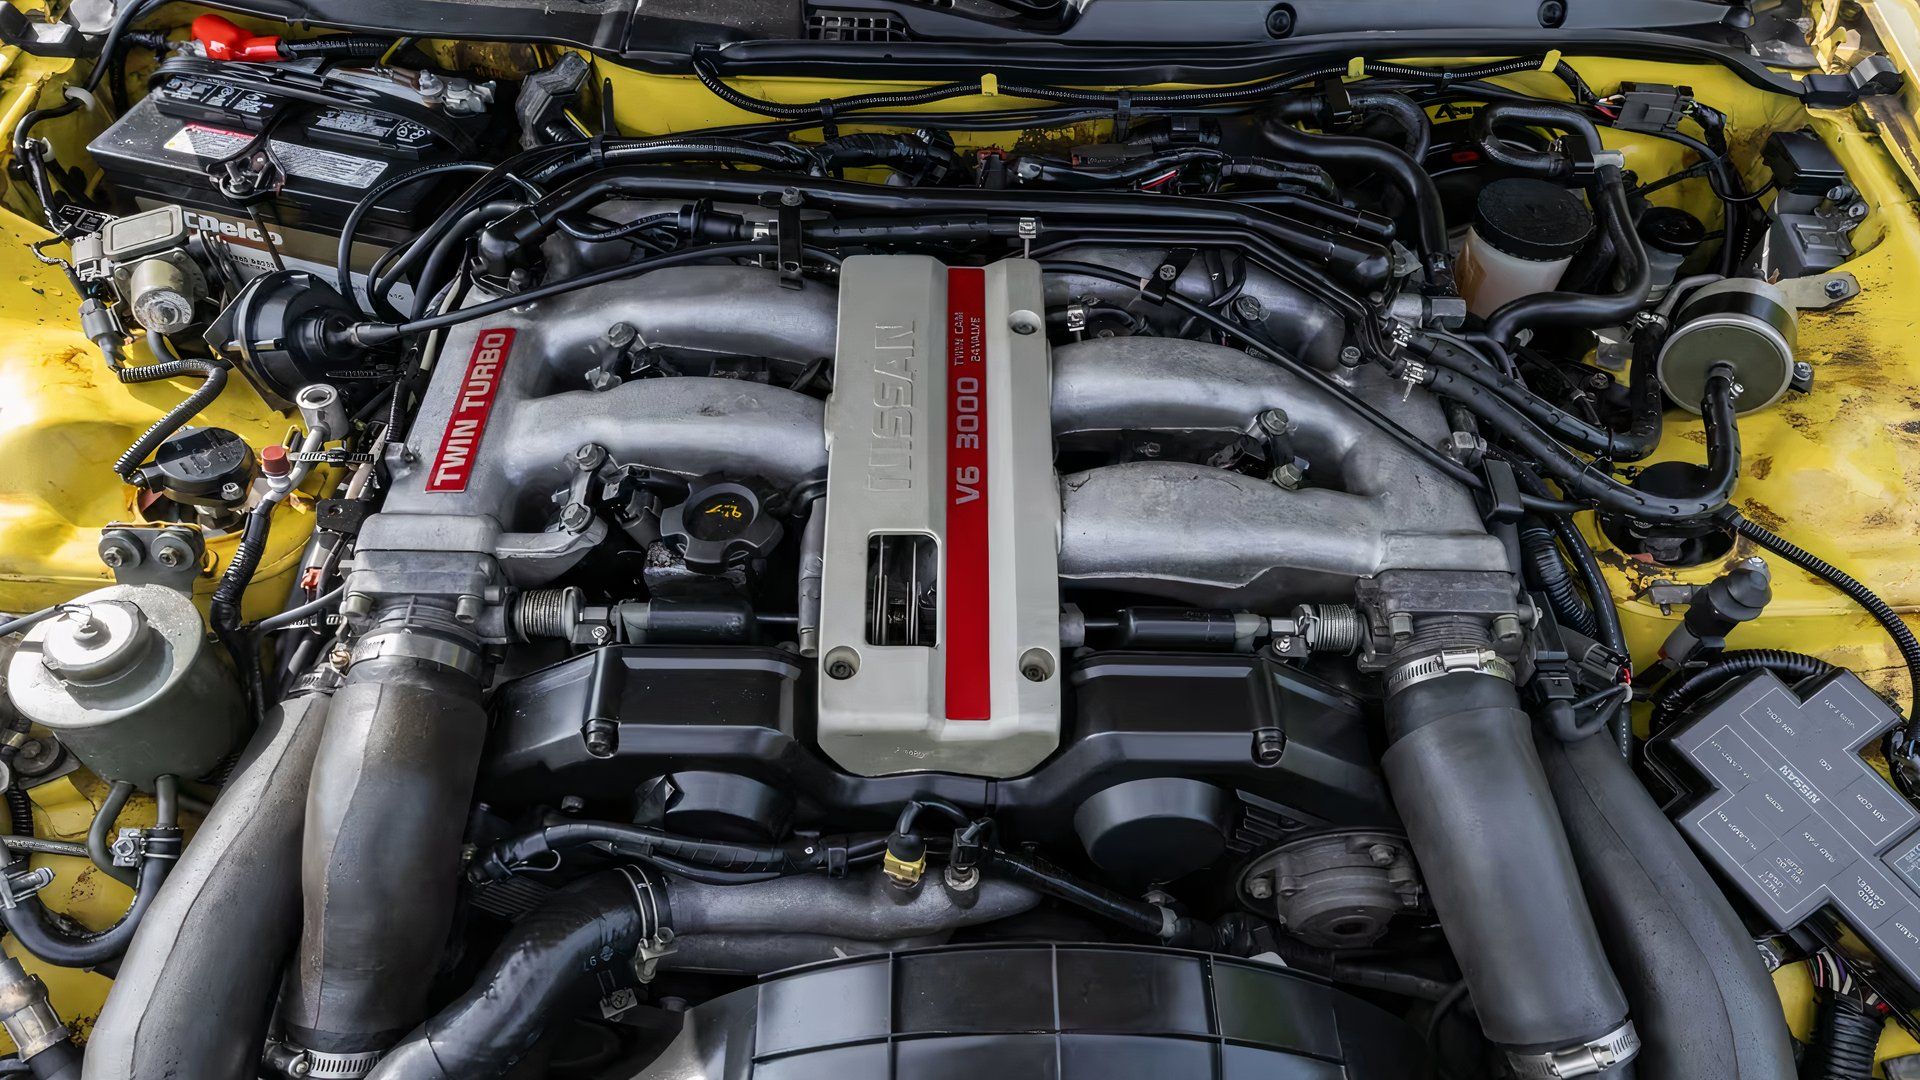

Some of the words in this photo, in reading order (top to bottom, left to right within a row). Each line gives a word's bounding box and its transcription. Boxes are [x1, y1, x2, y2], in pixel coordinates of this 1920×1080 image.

[184, 211, 283, 245] CDelco
[433, 419, 479, 486] TWIN
[459, 333, 506, 413] TURBO
[866, 320, 915, 491] NISSAN
[956, 377, 979, 449] 3000
[955, 466, 980, 505] V6
[1778, 764, 1821, 804] NISSAN
